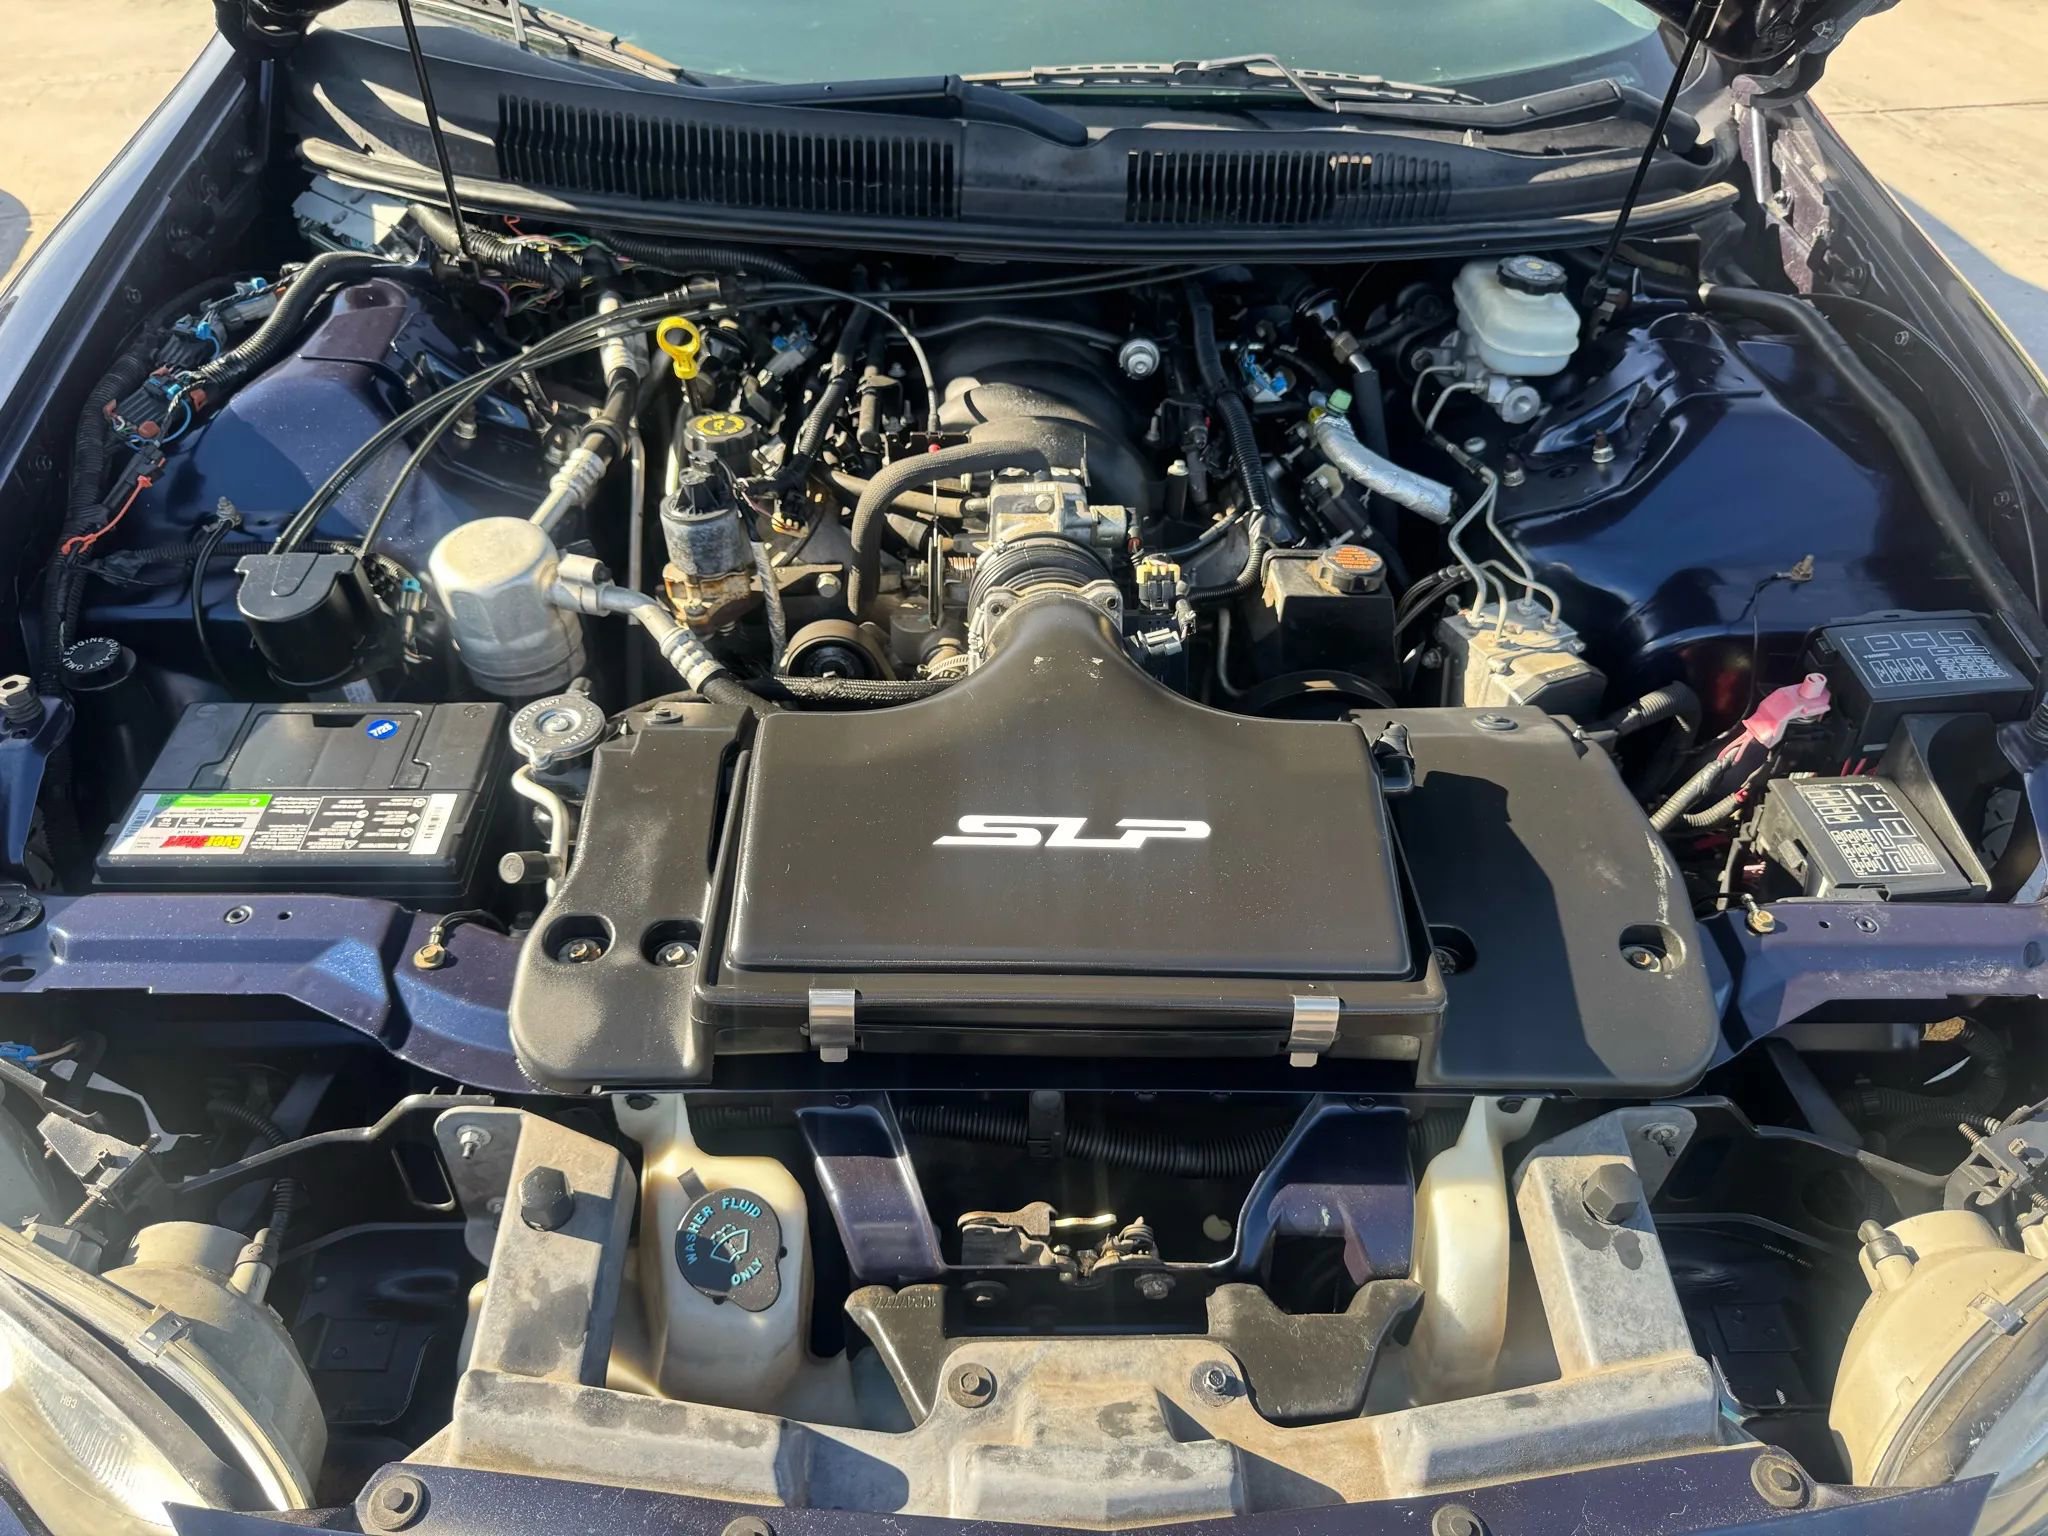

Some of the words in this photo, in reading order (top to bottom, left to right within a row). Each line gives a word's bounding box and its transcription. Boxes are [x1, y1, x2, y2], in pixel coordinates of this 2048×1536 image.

[64, 637, 105, 656] ENGINE
[89, 638, 121, 669] COOLANT
[62, 657, 84, 671] ONLY
[160, 835, 245, 848] EverStart
[932, 814, 1211, 848] SLP
[685, 1205, 715, 1266] WASHER
[721, 1196, 763, 1218] FLUID
[731, 1257, 765, 1287] ONLY
